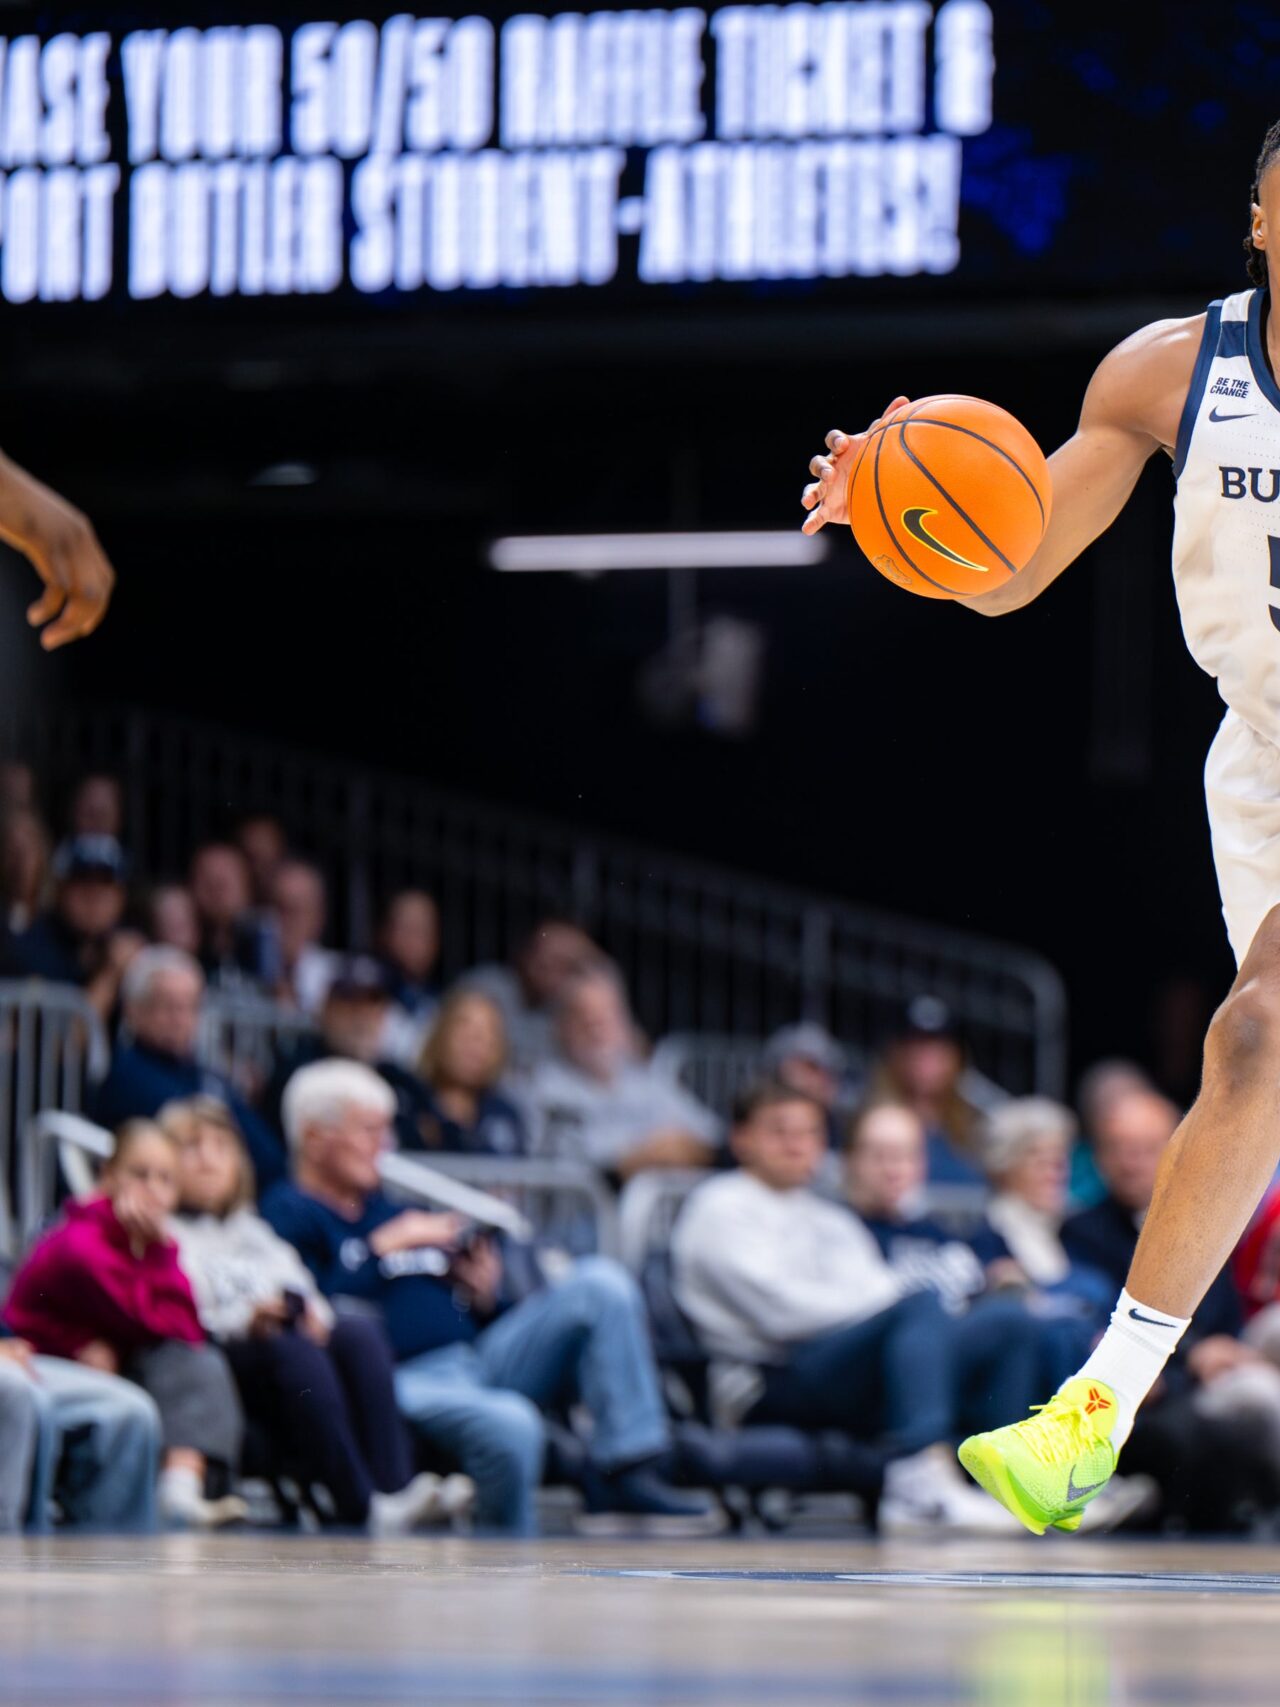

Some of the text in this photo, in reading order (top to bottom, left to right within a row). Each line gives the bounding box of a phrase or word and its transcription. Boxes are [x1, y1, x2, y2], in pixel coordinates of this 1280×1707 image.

[0, 32, 111, 170] ASE
[290, 14, 495, 162] 50/50
[0, 162, 120, 303] ORT
[128, 155, 344, 299] BUTLER
[1210, 385, 1249, 398] CHANGE
[1216, 376, 1250, 390] BE THE
